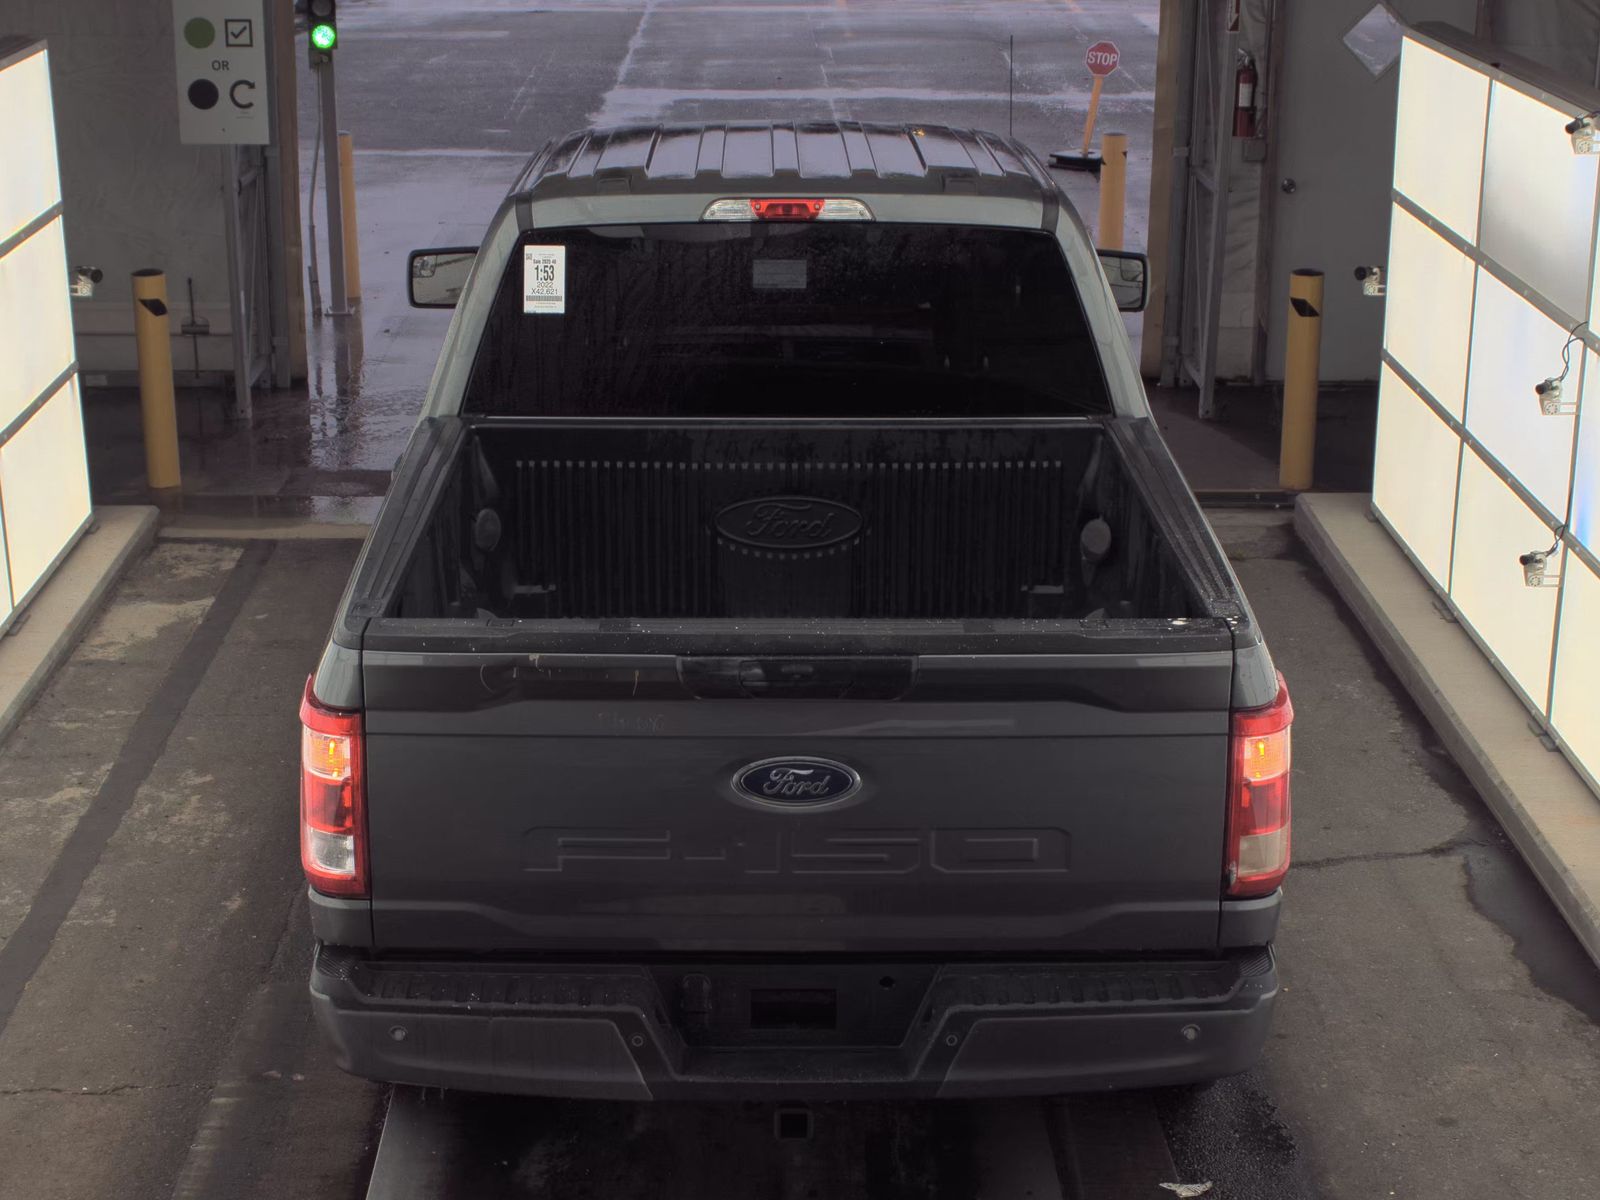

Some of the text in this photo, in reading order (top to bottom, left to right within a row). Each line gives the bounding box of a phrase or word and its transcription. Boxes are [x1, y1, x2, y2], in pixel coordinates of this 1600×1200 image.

[211, 60, 230, 71] OR
[1087, 51, 1118, 65] STOP
[534, 265, 555, 281] 1:53
[536, 281, 553, 289] 2022
[744, 501, 834, 536] Ford
[762, 767, 831, 795] Ford
[521, 826, 1071, 874] F-150
